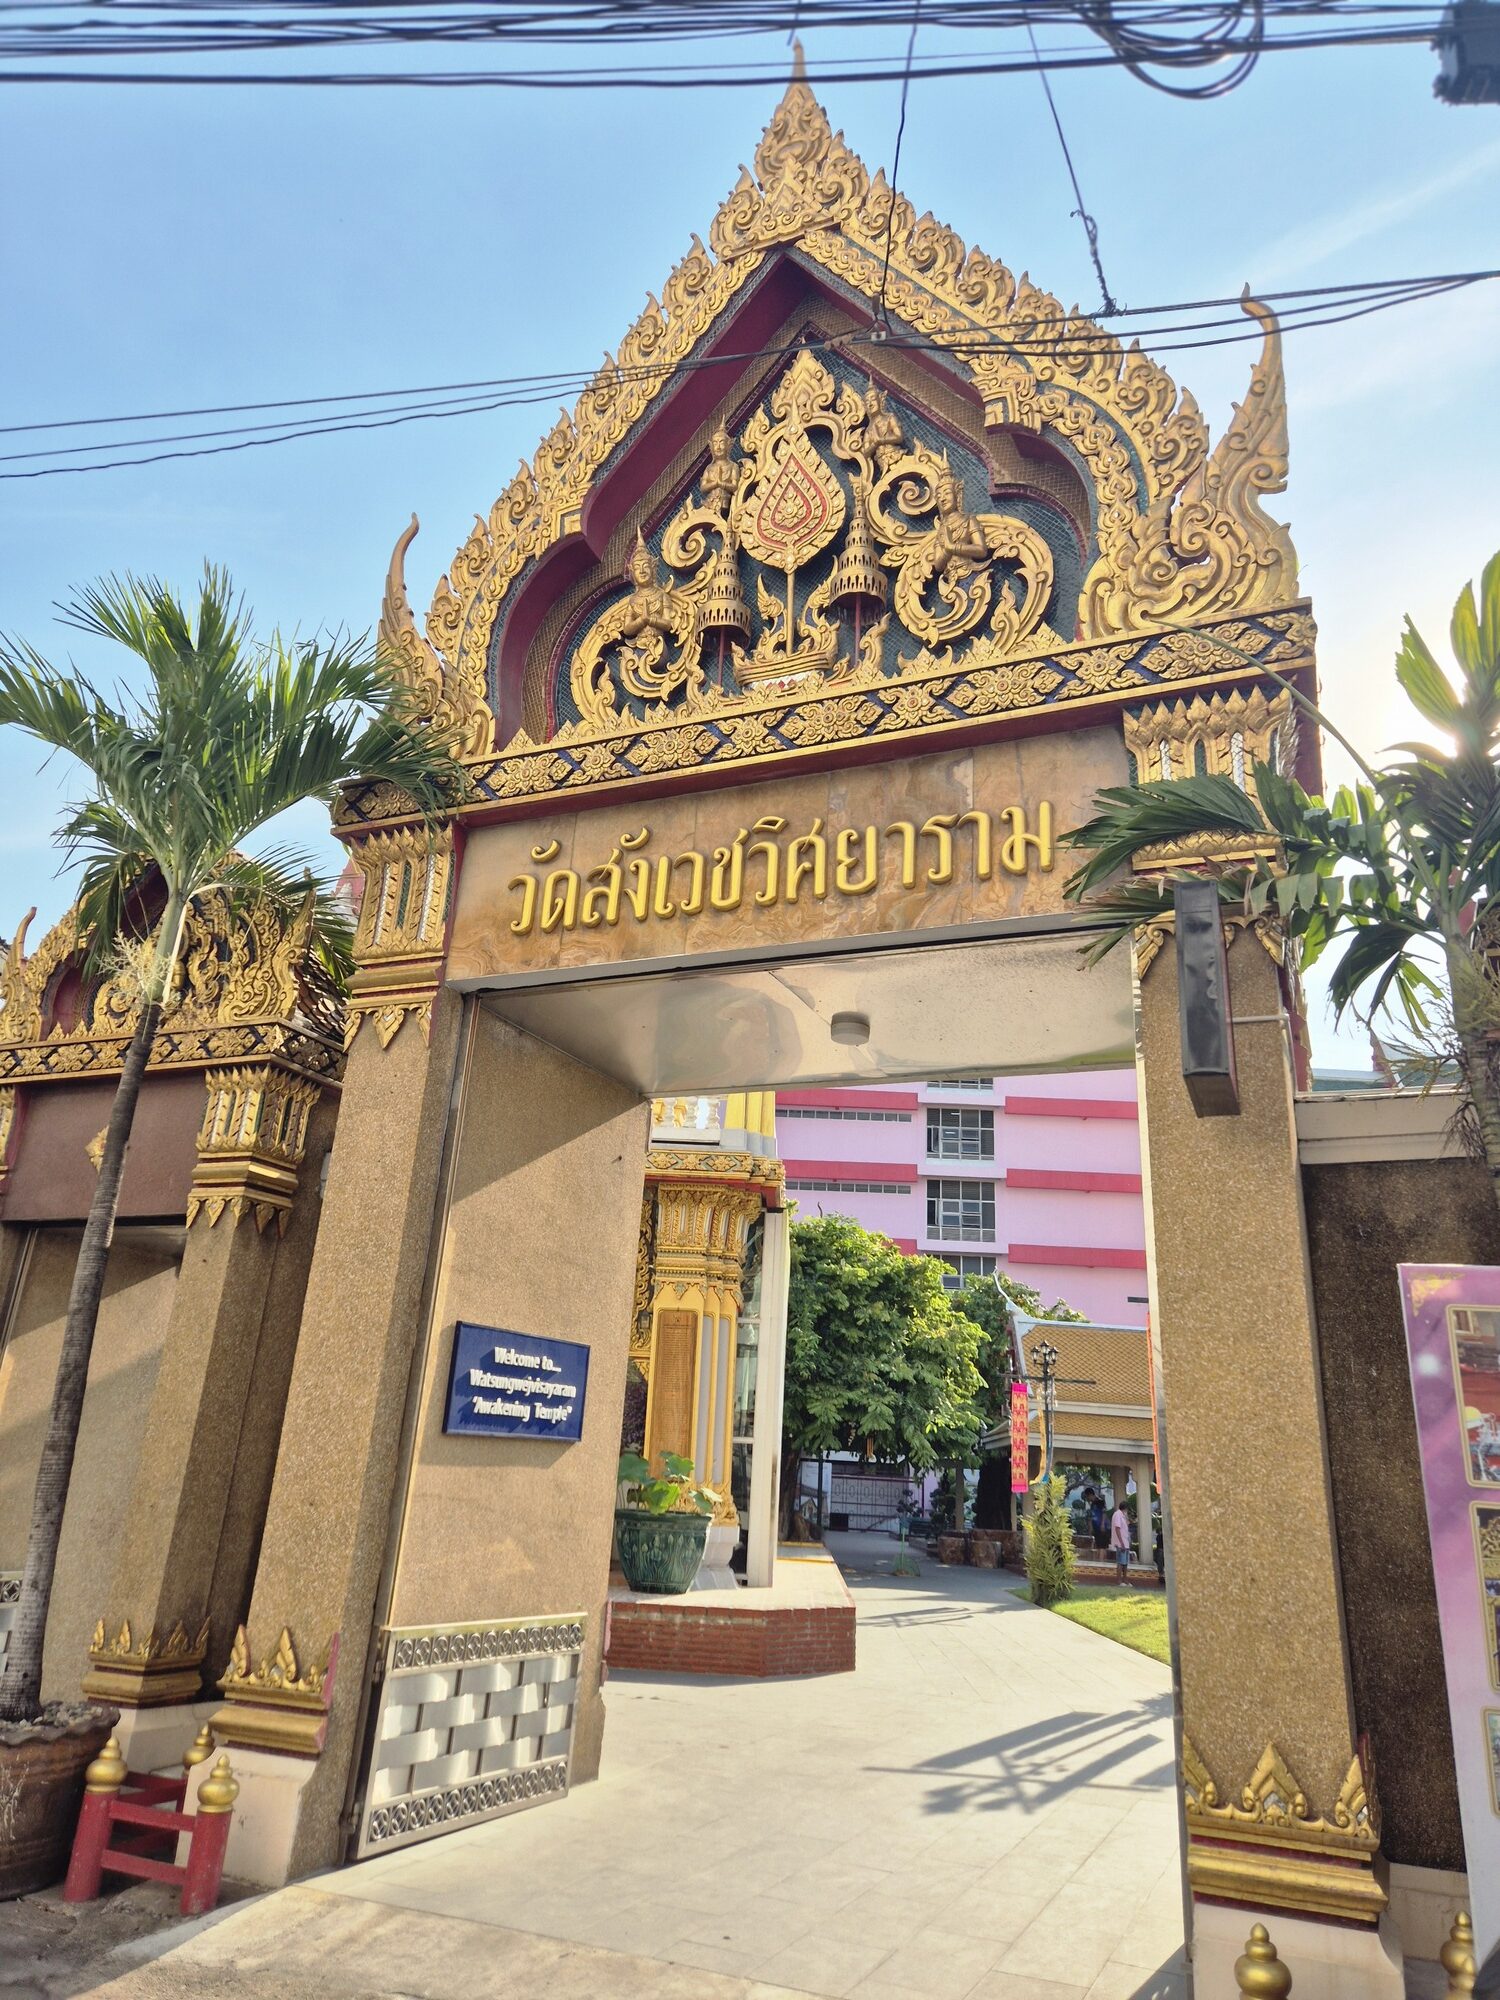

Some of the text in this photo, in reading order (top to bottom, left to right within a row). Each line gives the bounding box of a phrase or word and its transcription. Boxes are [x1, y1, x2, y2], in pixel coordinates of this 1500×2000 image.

[509, 800, 1055, 936] วัดสังเวชวิศยาราม
[494, 1346, 540, 1368] Welcome
[535, 1402, 572, 1424] Temple"
